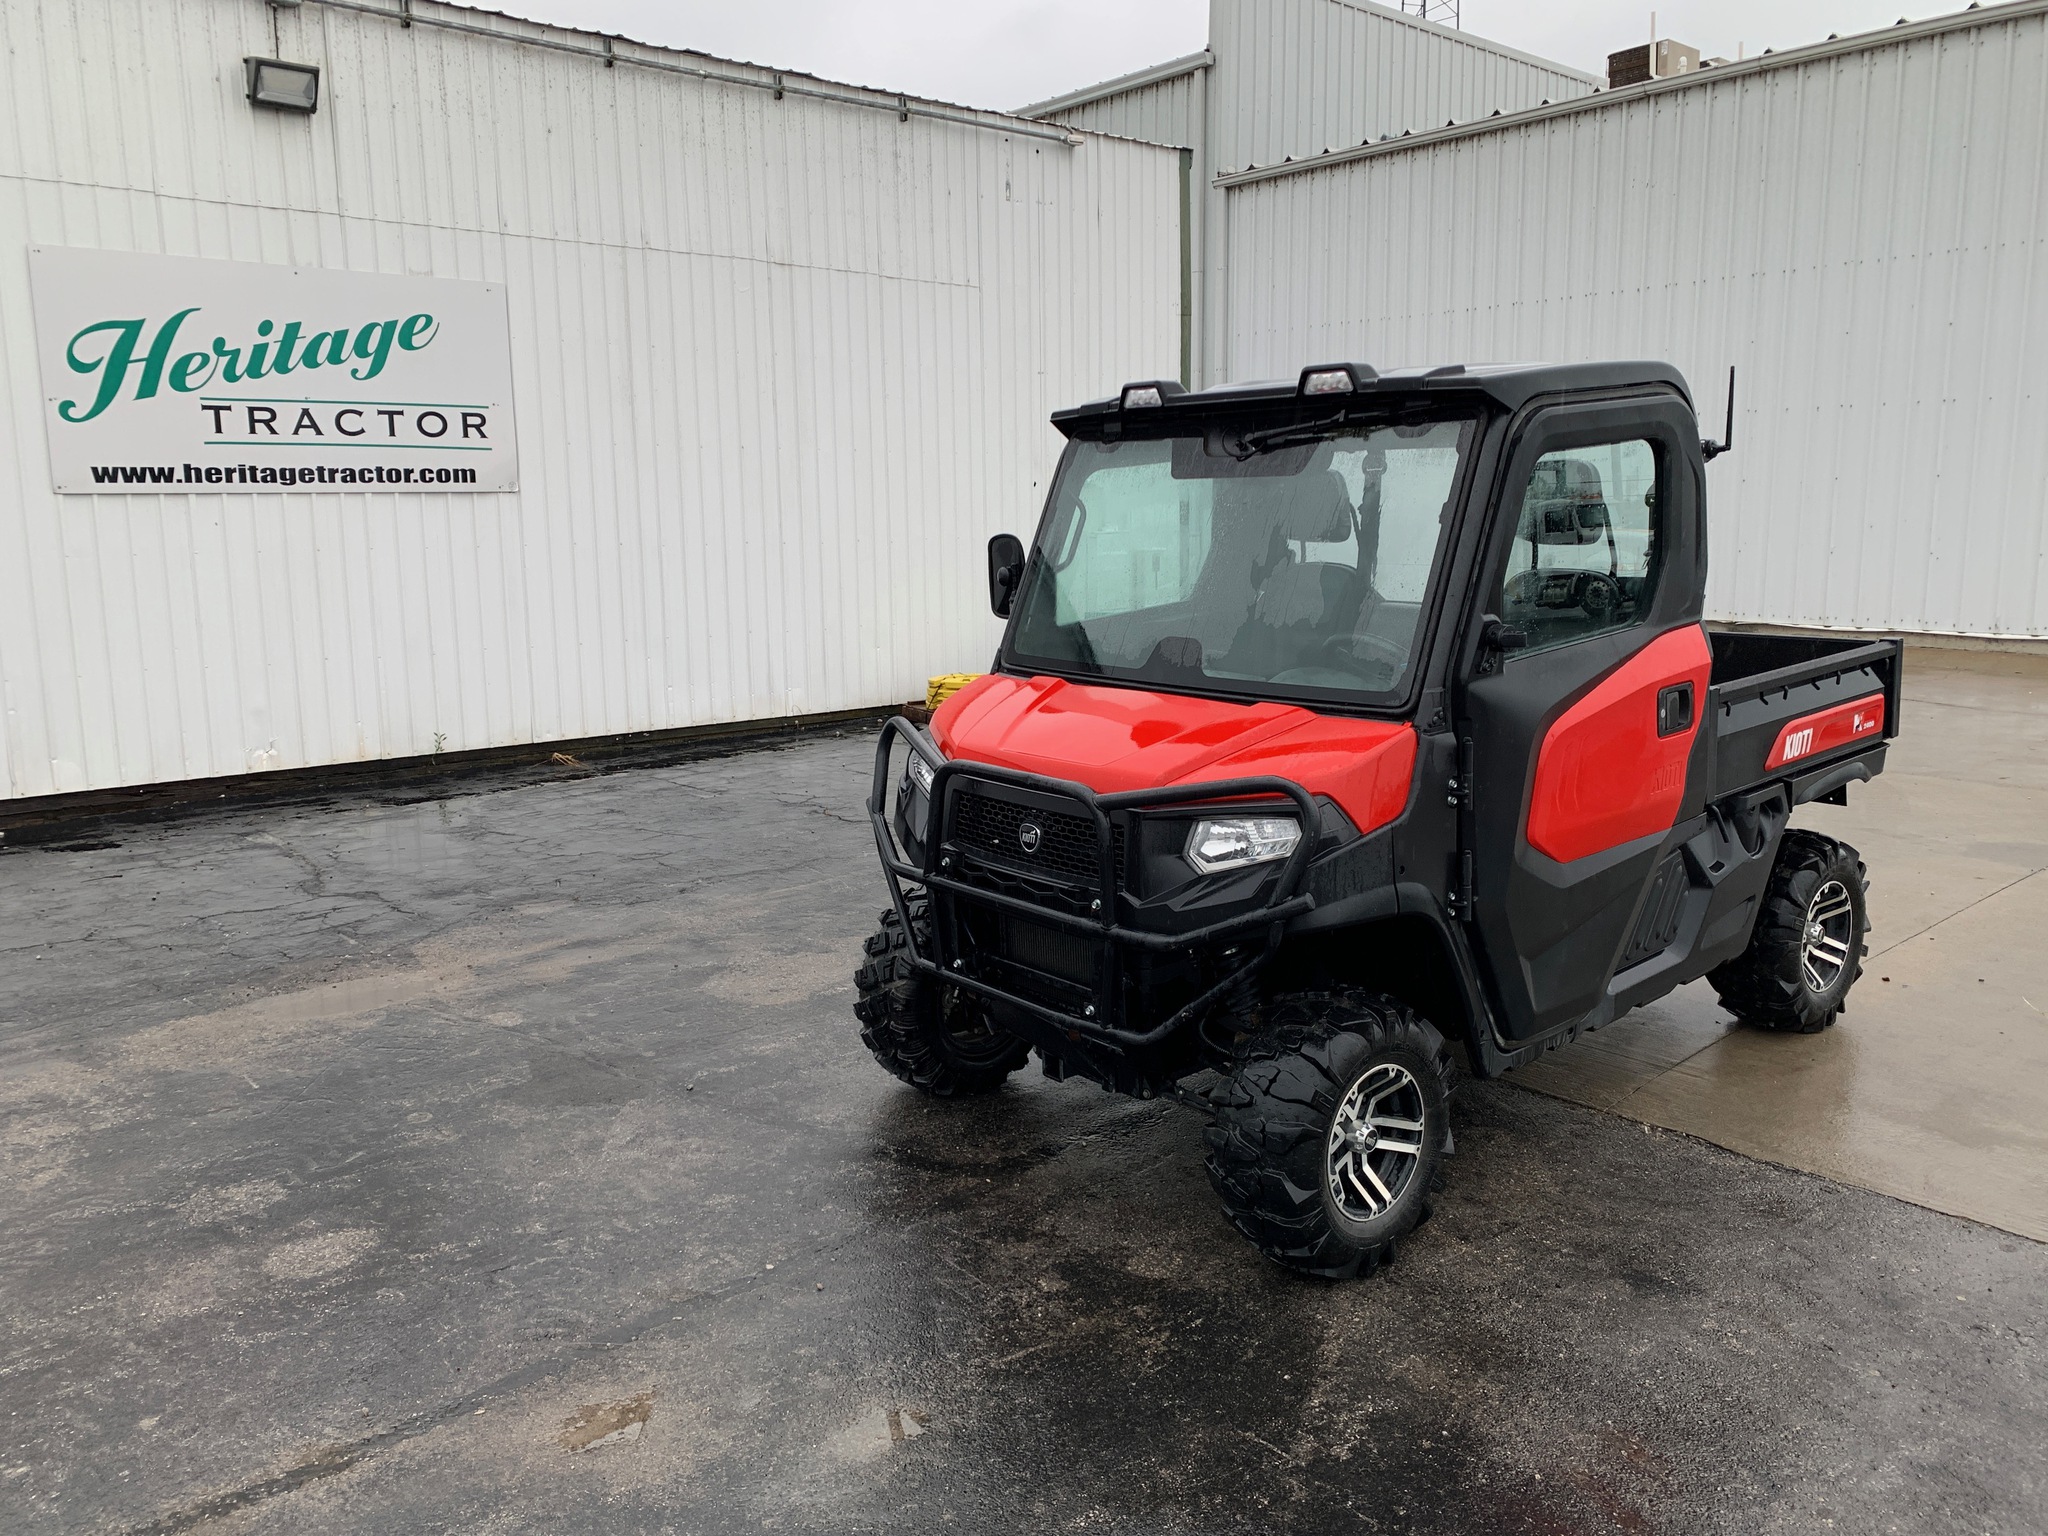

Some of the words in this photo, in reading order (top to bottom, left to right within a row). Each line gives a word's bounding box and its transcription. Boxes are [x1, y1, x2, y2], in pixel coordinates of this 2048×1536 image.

[57, 307, 441, 423] Heritage
[201, 403, 489, 440] TRACTOR
[90, 463, 477, 486] www.heritagetractor.com
[1782, 728, 1814, 761] KIOTI
